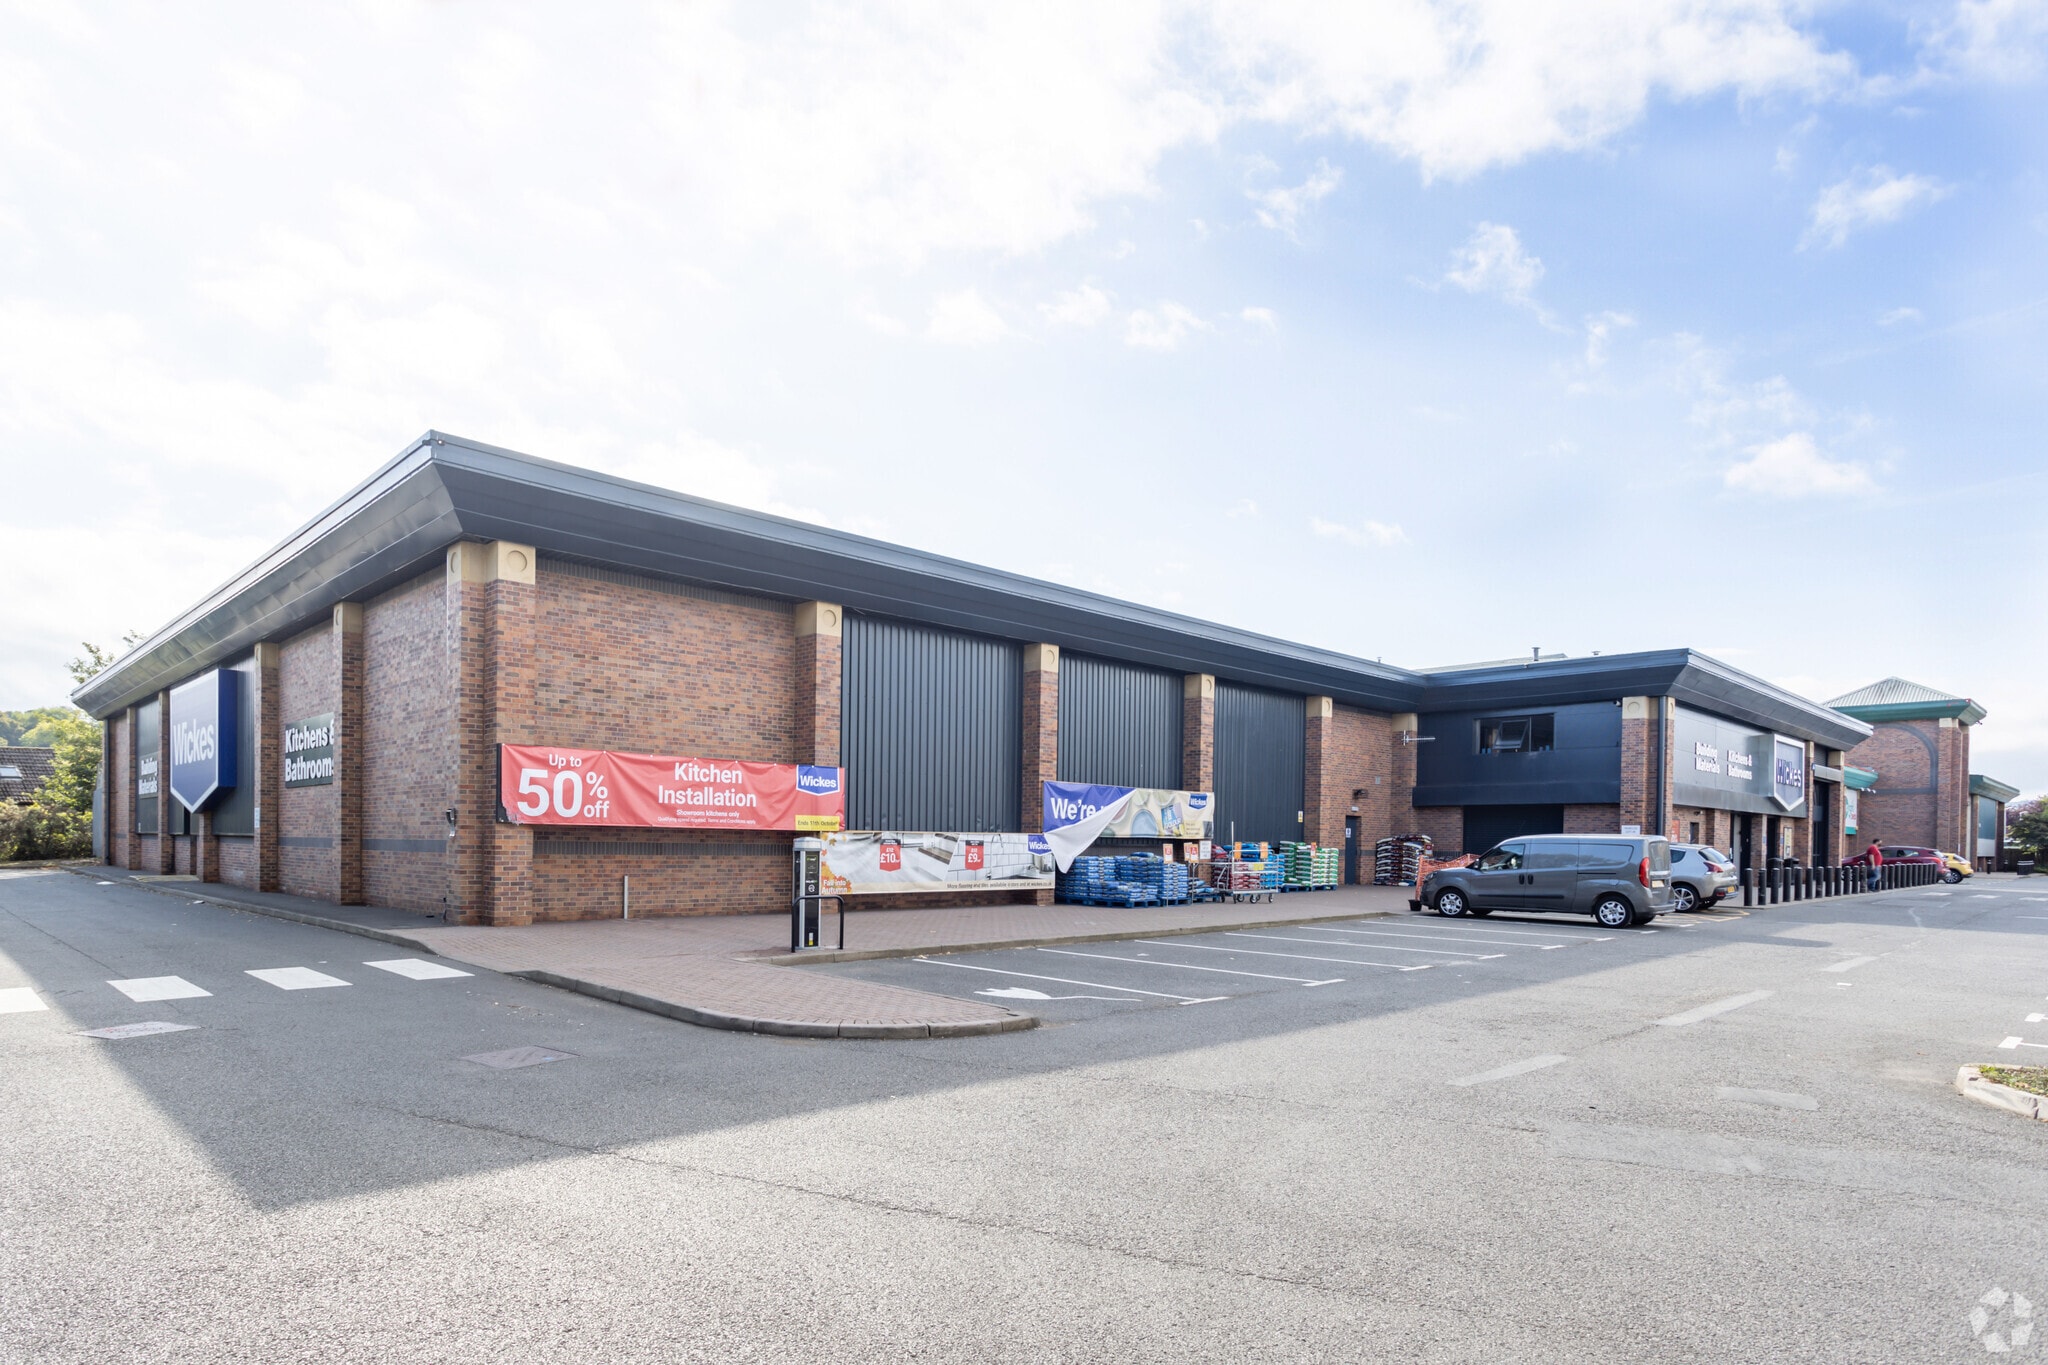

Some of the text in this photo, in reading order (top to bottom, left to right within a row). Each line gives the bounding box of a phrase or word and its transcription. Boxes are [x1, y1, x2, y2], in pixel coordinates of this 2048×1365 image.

[173, 718, 215, 766] Wickes
[285, 725, 329, 754] Kitchens
[1695, 741, 1718, 760] Building
[1727, 750, 1748, 766] Kitchens
[548, 753, 582, 769] Up to
[1695, 757, 1720, 774] Materials
[674, 762, 742, 784] Kitchen
[1727, 764, 1752, 780] Bathrooms
[1776, 758, 1802, 788] Wickes
[800, 775, 837, 788] Wickes
[658, 785, 757, 807] Installation
[1190, 798, 1206, 806] Wickes
[583, 800, 610, 818] off
[676, 808, 740, 818] Showroom kitchens only
[1050, 797, 1097, 820] We're
[822, 886, 847, 894] Autumn
